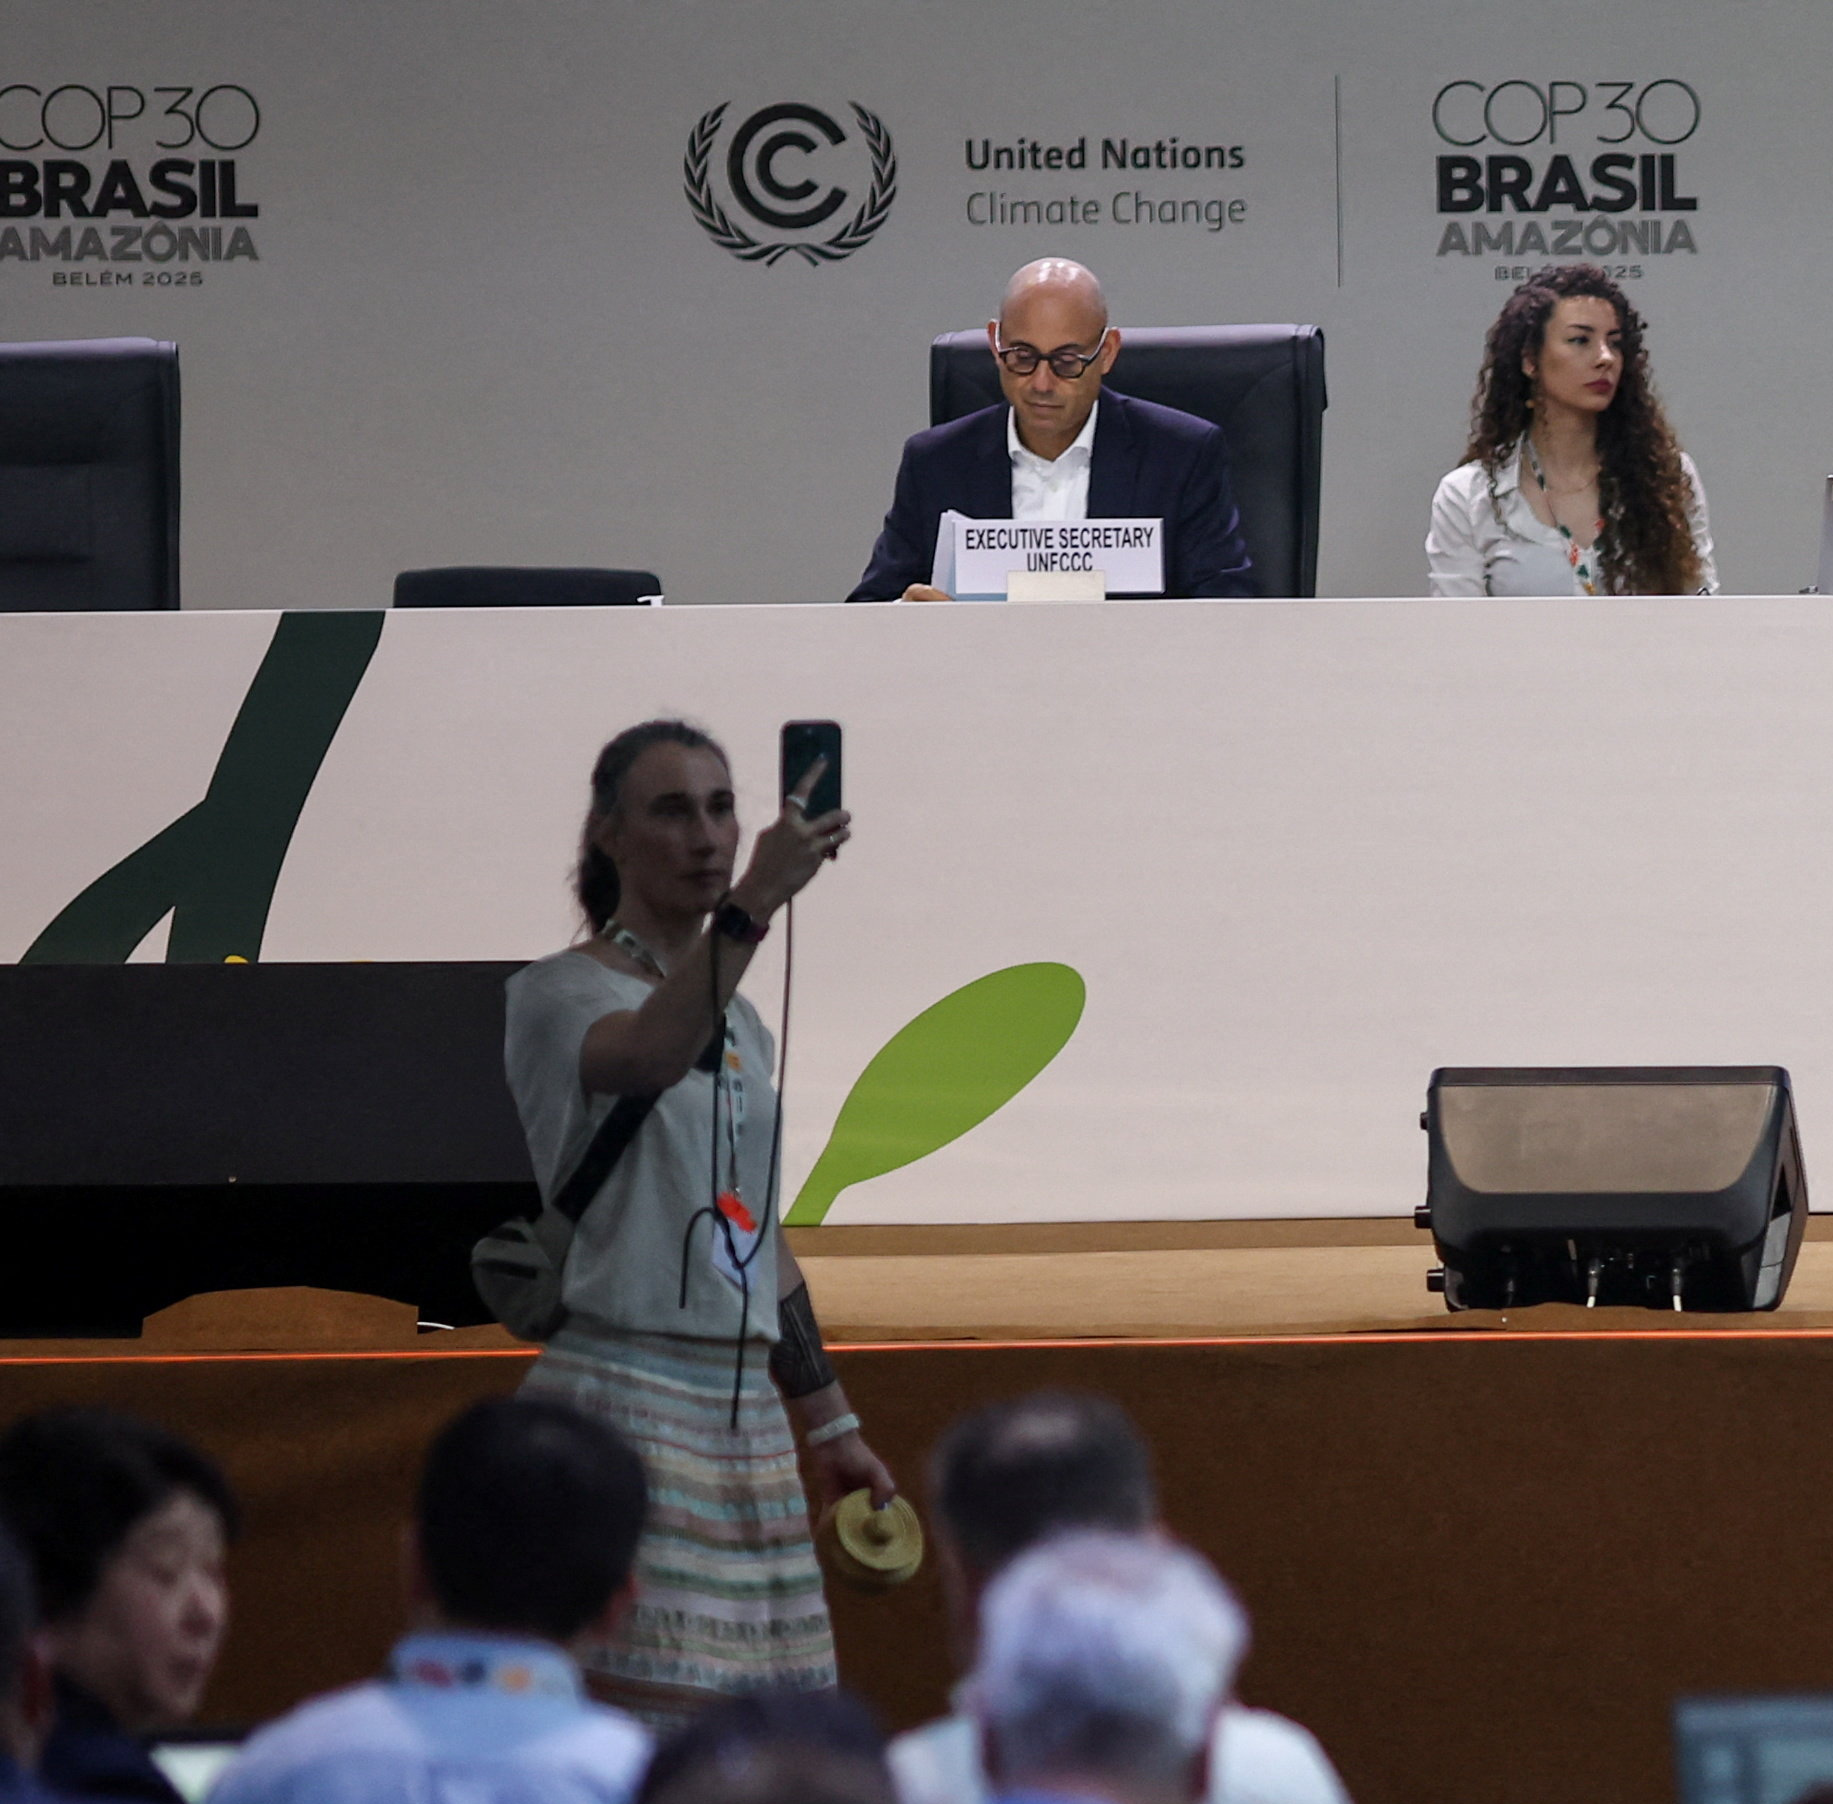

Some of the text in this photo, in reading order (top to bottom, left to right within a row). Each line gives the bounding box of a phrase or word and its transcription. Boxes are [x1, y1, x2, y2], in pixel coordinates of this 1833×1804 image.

[966, 137, 1244, 170] United Nations
[0, 158, 258, 219] BRASIL
[1436, 153, 1697, 213] BRASIL
[967, 191, 1246, 232] Climate Change
[0, 218, 259, 263] AMAZÔNIA
[1436, 214, 1697, 256] AMAZÔNIA
[53, 270, 203, 286] BELÉM 2025
[966, 528, 1153, 549] EXECUTIVE SECRETARY
[1027, 552, 1093, 571] UNFCCC
